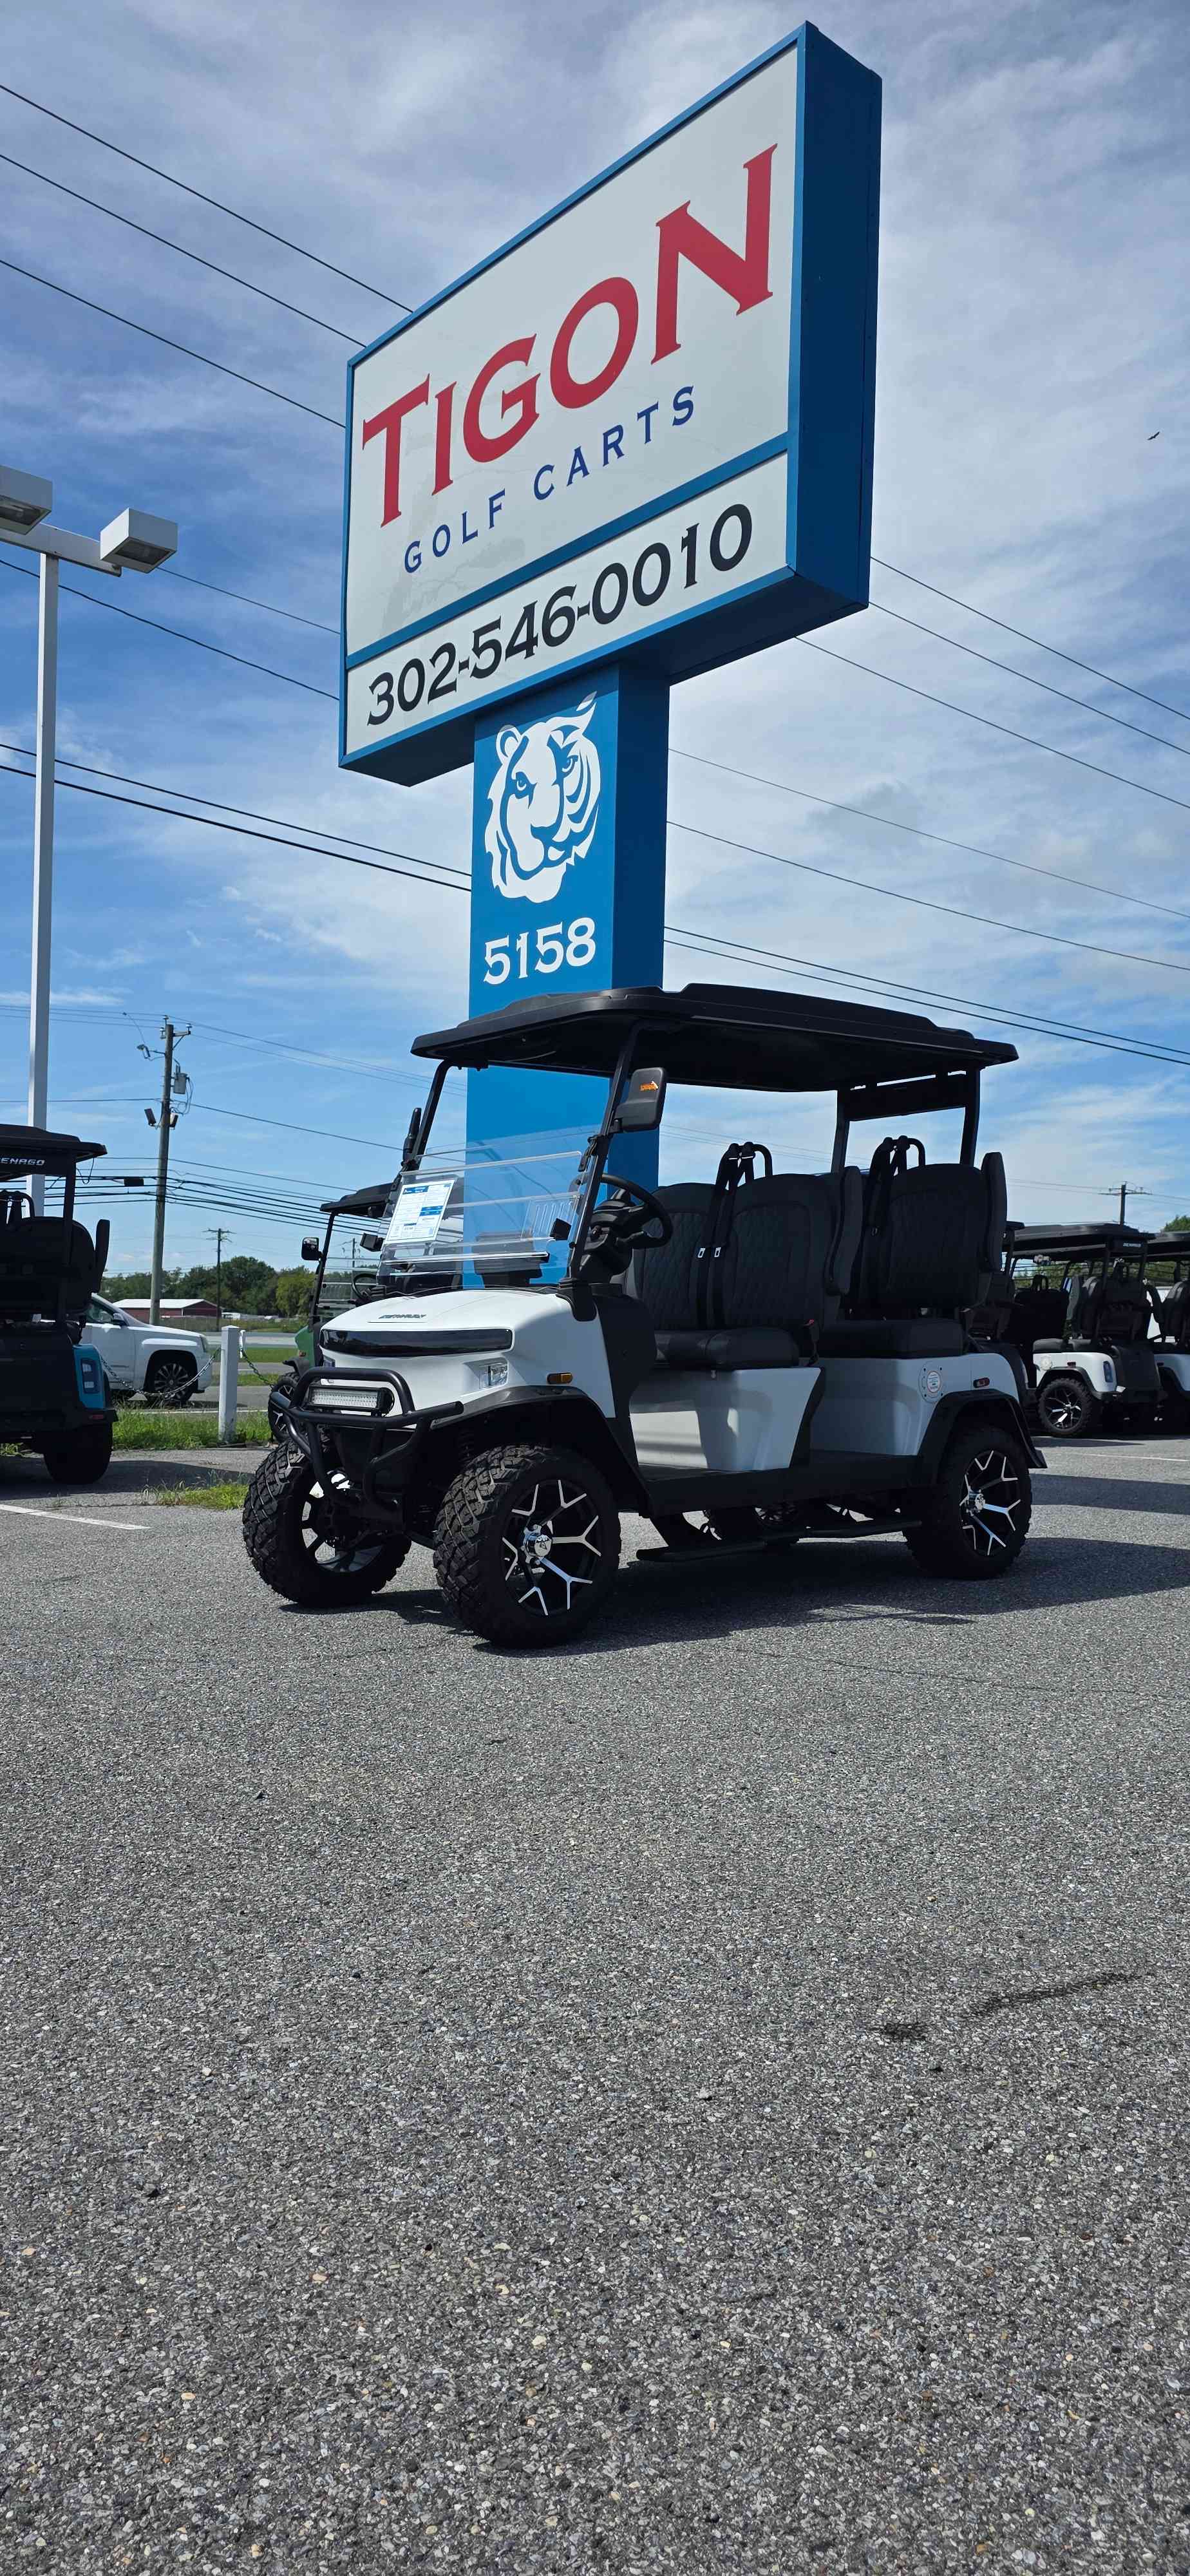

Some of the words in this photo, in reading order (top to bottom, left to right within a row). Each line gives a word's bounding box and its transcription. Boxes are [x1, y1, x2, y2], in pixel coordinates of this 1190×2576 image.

[363, 144, 777, 527] TIGON
[404, 489, 505, 573] GOLF
[534, 386, 695, 500] CARTS
[368, 504, 752, 726] 302-546-0010
[484, 917, 596, 985] 5158
[0, 1157, 45, 1166] ENAGO
